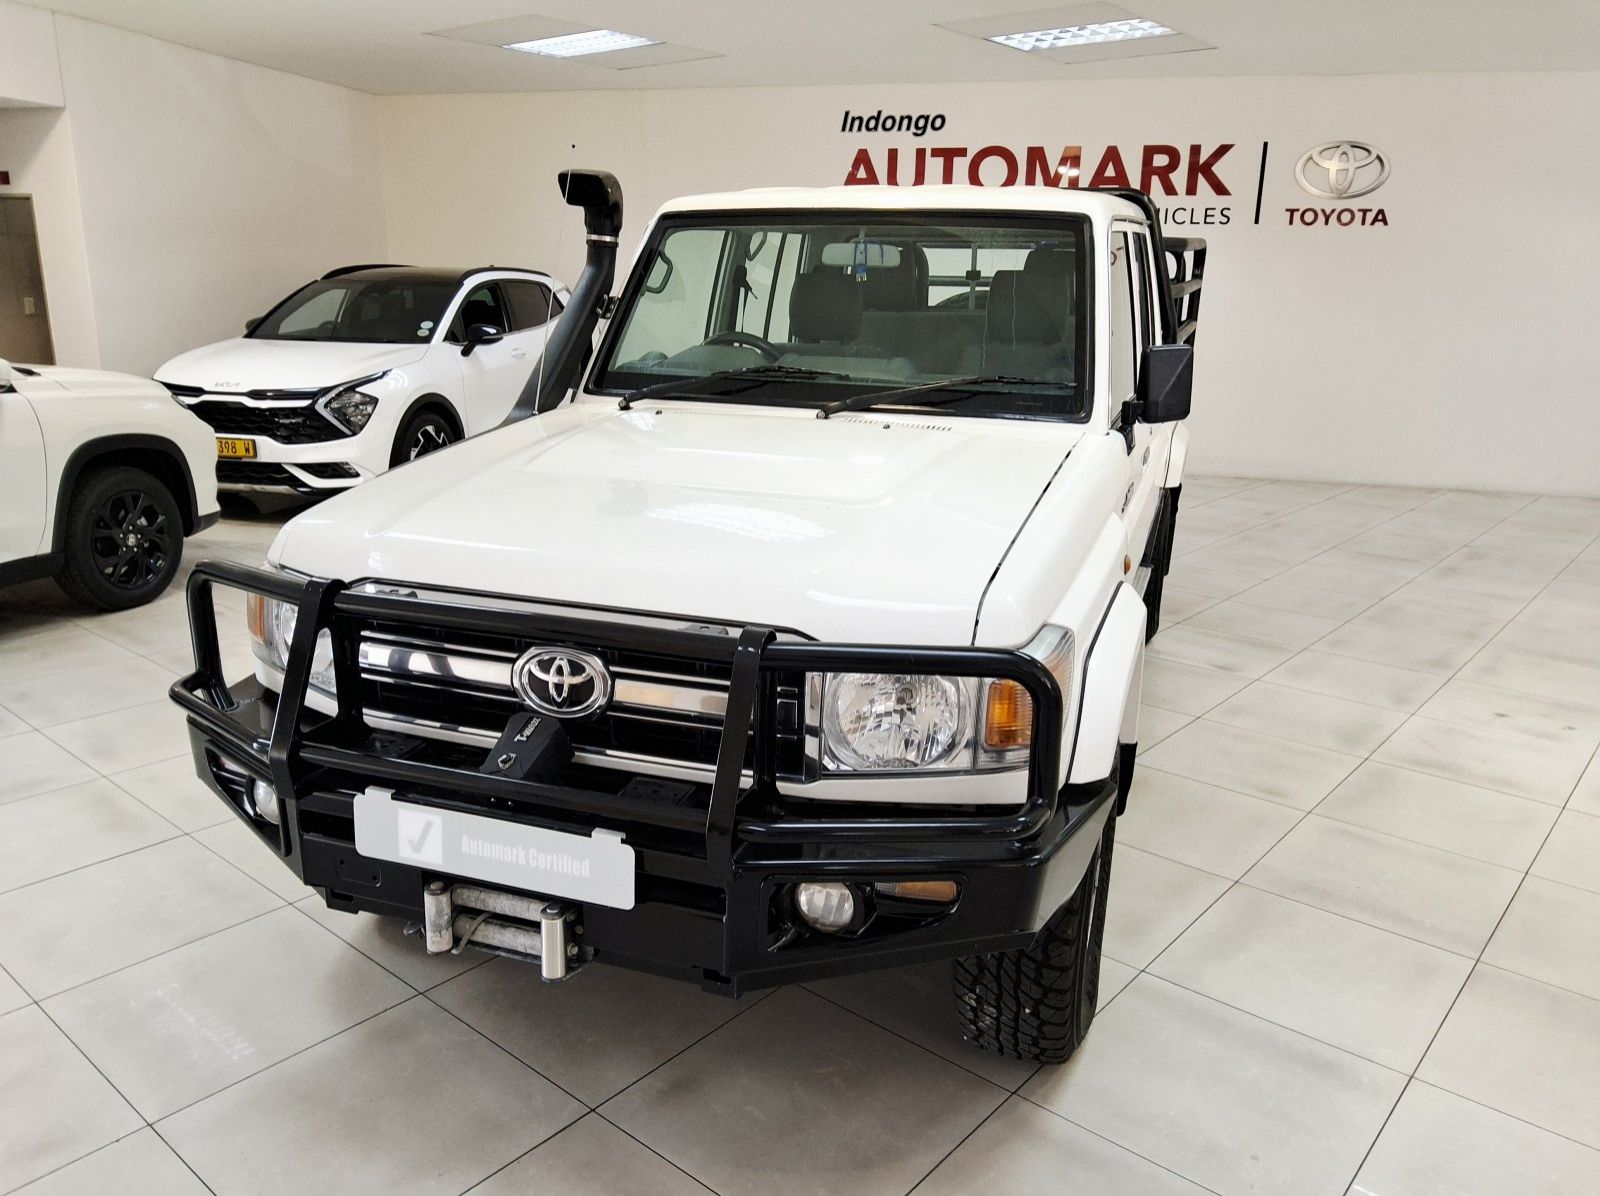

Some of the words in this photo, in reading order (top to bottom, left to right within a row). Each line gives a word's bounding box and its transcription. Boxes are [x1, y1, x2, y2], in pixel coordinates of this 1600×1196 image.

[841, 110, 946, 137] Indongo
[843, 143, 1236, 197] AUTOMARK
[1157, 207, 1231, 225] ICLES
[1286, 208, 1389, 226] TOYOTA
[461, 835, 526, 866] Automark
[528, 847, 590, 878] Certified
